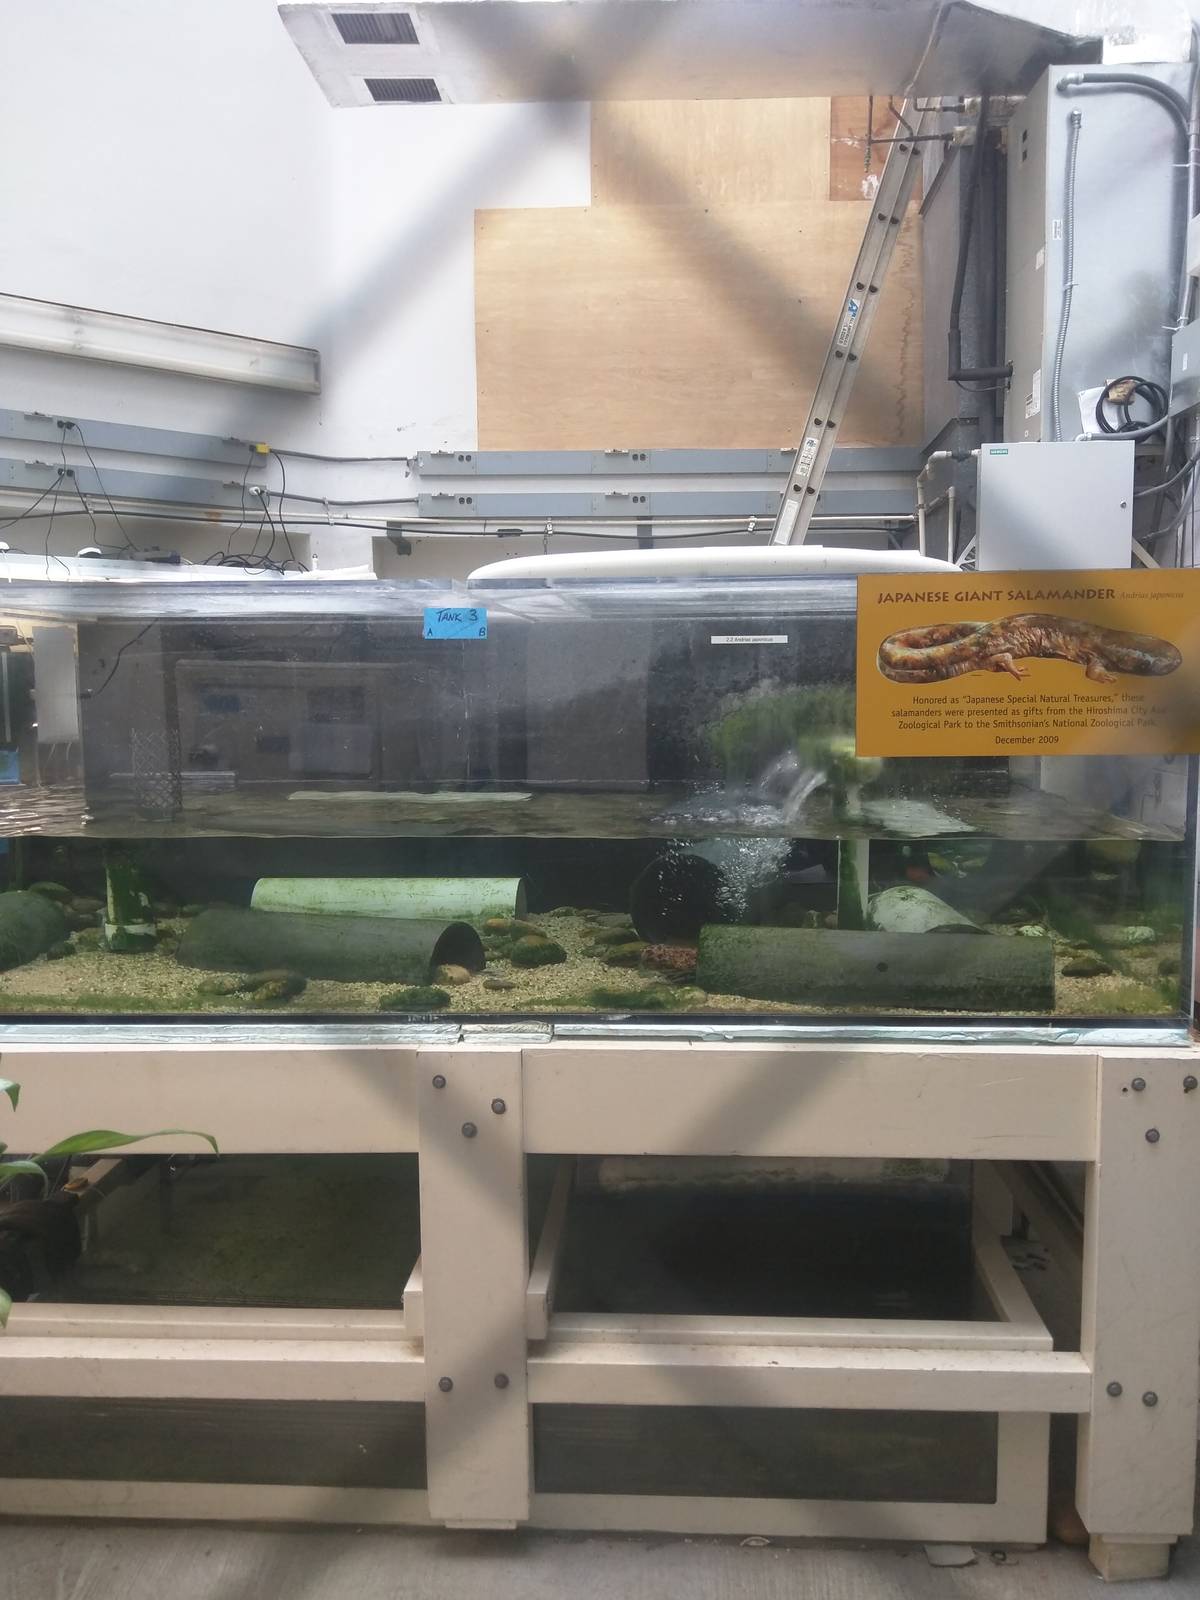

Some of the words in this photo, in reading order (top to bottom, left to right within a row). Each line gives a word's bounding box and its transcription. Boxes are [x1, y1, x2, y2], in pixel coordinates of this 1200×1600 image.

[878, 591, 949, 604] JAPANESE
[954, 590, 1003, 602] GIANT
[1007, 588, 1115, 601] SALAMANDER
[436, 608, 462, 623] TANK
[469, 608, 478, 621] 3
[427, 627, 433, 637] A
[479, 626, 486, 637] B
[912, 696, 948, 704] Honored
[1007, 694, 1037, 705] Special
[1040, 694, 1070, 703] Natural
[1121, 692, 1145, 702] these
[891, 708, 943, 717] salamanders
[967, 707, 1008, 717] presented
[1011, 708, 1020, 716] as
[1023, 706, 1043, 717] gifts
[1046, 706, 1066, 715] from
[1069, 706, 1083, 715] the
[1086, 706, 1128, 715] Hiroshima
[1131, 705, 1148, 716] City
[898, 720, 941, 731] Zoological
[944, 720, 961, 728] Park
[964, 720, 973, 728] to
[976, 719, 990, 728] the
[993, 719, 1050, 728] Smithsonian's
[1052, 719, 1088, 728] National
[1090, 718, 1134, 728] Zoological
[995, 736, 1036, 744] December
[1038, 735, 1060, 744] 2009
